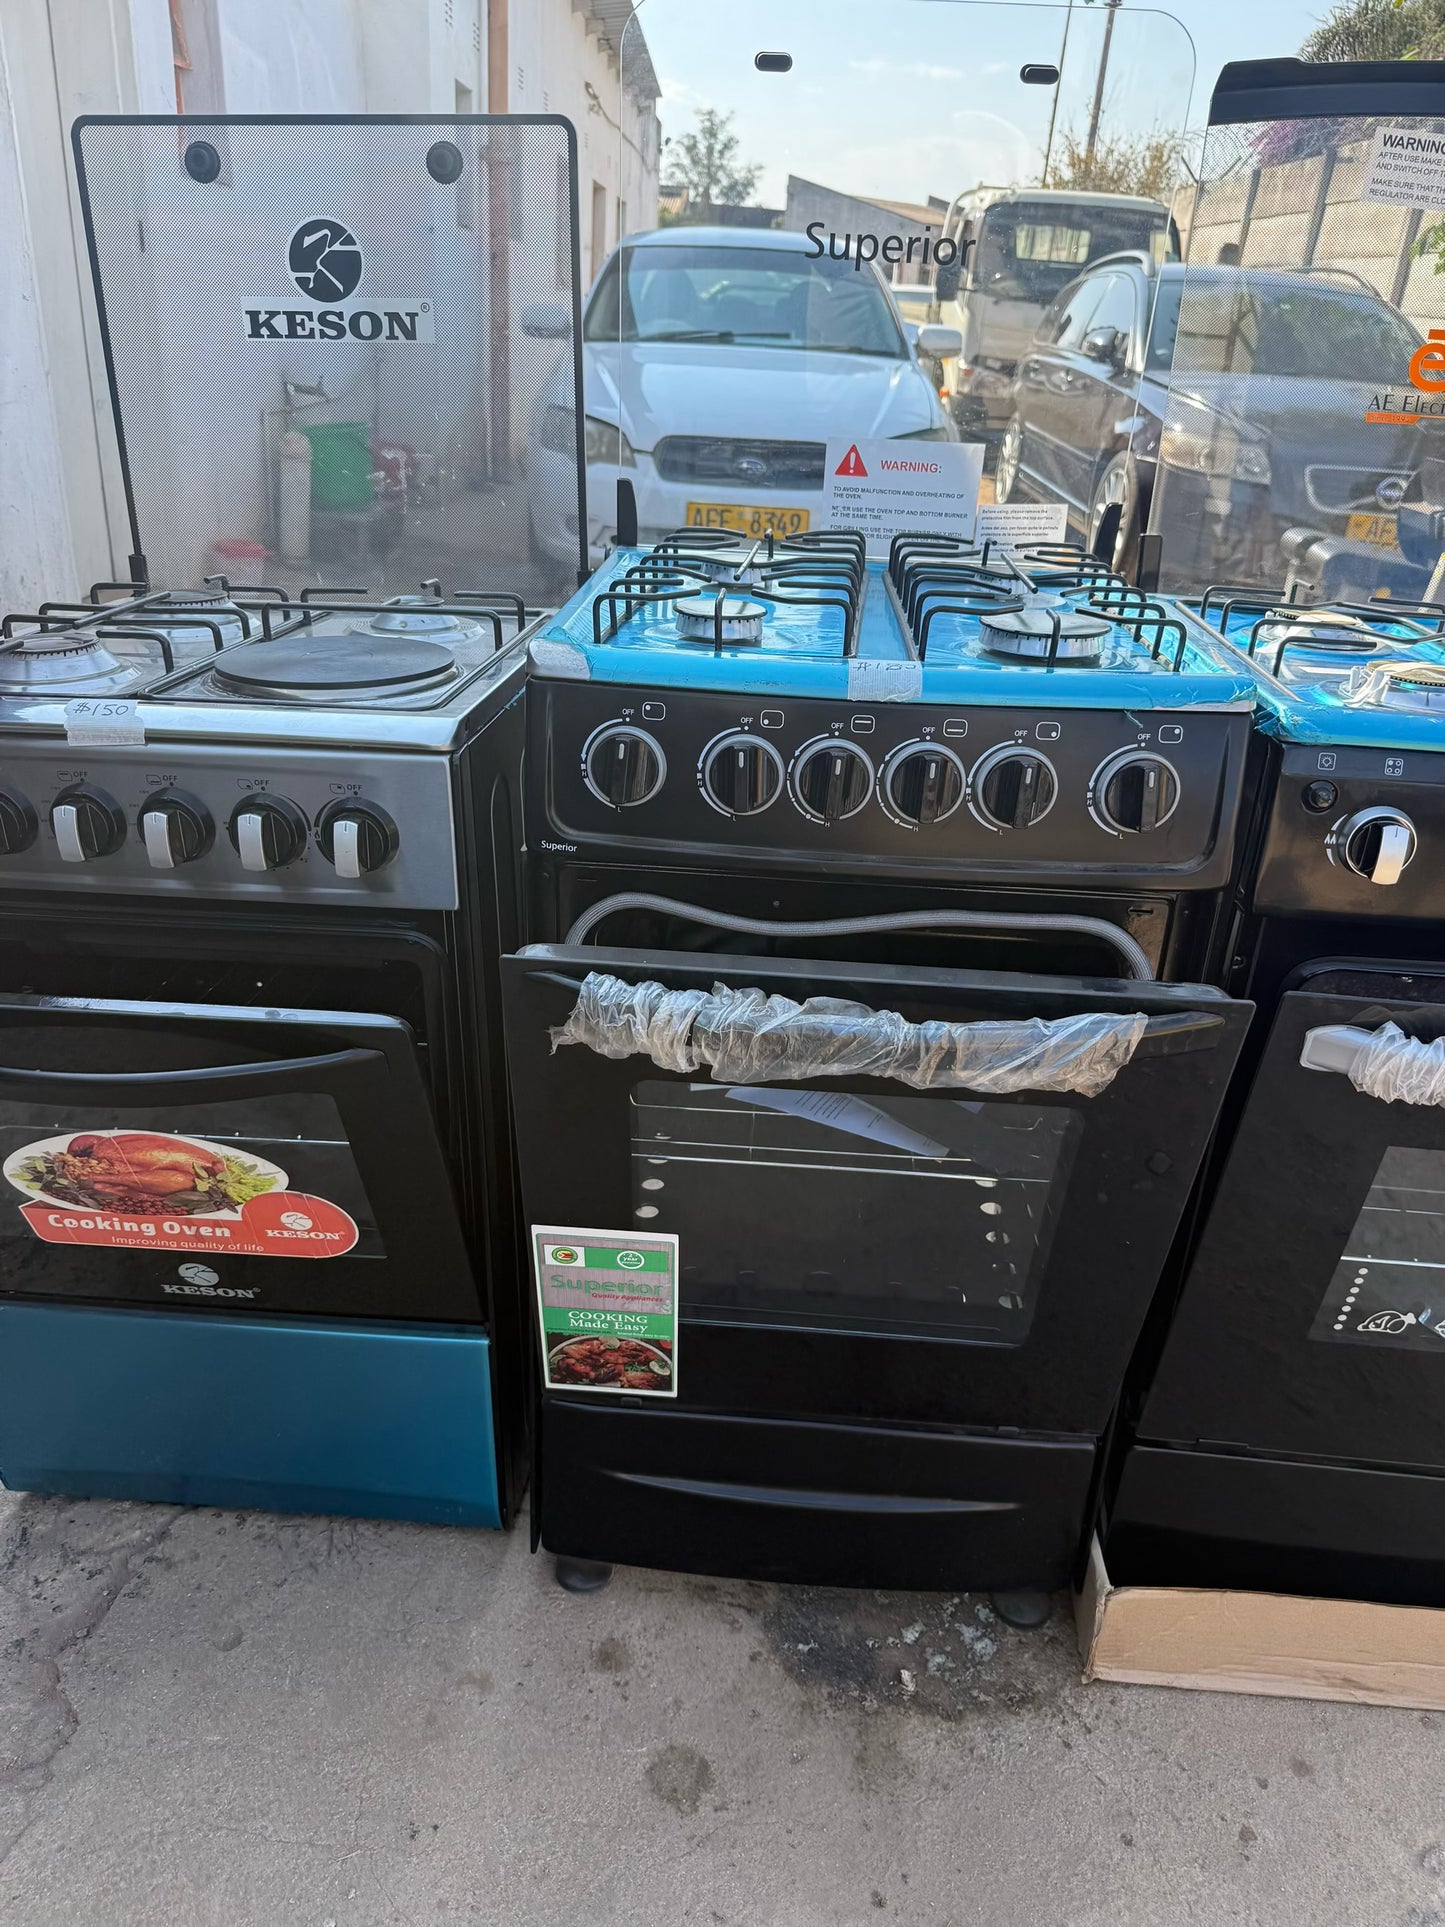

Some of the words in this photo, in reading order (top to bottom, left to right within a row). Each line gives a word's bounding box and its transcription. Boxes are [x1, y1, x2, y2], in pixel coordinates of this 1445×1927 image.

[1378, 152, 1403, 161] AFTER
[1404, 154, 1420, 163] USE
[1421, 157, 1442, 167] MAKE
[1376, 162, 1392, 171] AND
[1393, 164, 1423, 175] SWITCH
[1424, 168, 1439, 176] OFF
[1371, 178, 1394, 187] MAKE
[1394, 181, 1415, 190] SURE
[1416, 184, 1436, 192] THAT
[1415, 195, 1431, 203] ARE
[804, 222, 976, 271] Superior
[245, 310, 419, 340] KESON
[1368, 394, 1395, 411] AE
[880, 460, 942, 474] WARNING:
[541, 840, 577, 852] Superior
[48, 1214, 156, 1236] Cooking
[163, 1221, 231, 1237] Oven
[266, 1230, 340, 1240] KESON
[112, 1236, 177, 1248] Improving
[180, 1240, 225, 1250] quality
[228, 1242, 242, 1250] of
[244, 1243, 264, 1252] life
[160, 1284, 254, 1298] KESON
[550, 1274, 664, 1296] Superior
[568, 1311, 648, 1323] COOKING
[570, 1319, 608, 1328] Made
[614, 1322, 648, 1333] Easy
